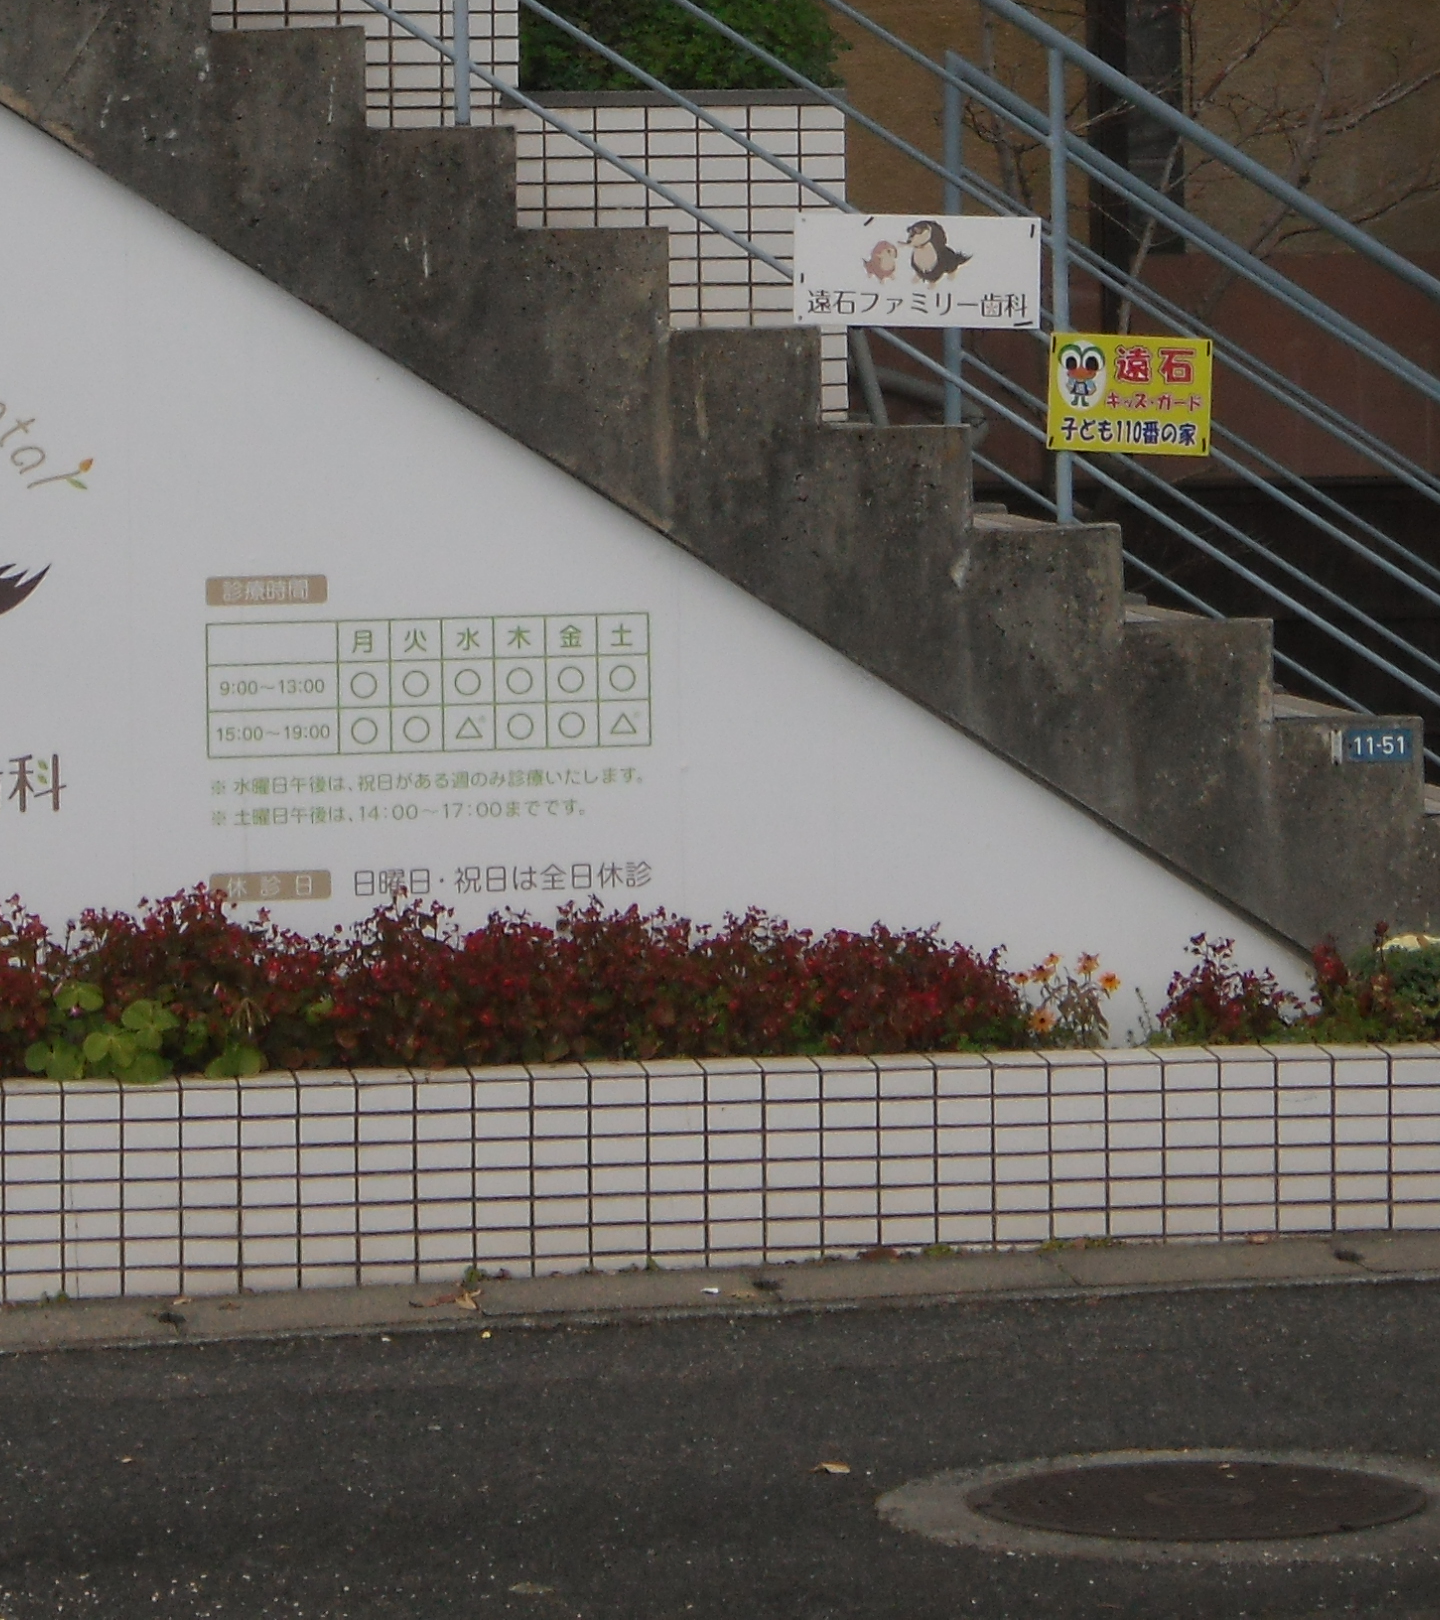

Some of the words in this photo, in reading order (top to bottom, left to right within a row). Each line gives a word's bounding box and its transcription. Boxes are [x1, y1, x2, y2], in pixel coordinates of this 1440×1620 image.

[807, 289, 1029, 319] 遠石ファミリー歯科
[1114, 345, 1196, 385] 遠石
[1061, 417, 1197, 447] 子ども110番の家
[222, 579, 309, 601] 診療時間
[352, 629, 373, 653] 月
[403, 628, 428, 651] 火
[456, 627, 481, 651] 水
[507, 625, 531, 649] 木
[559, 623, 583, 649] 金
[610, 622, 634, 647] 土
[1354, 736, 1404, 755] 11-51
[227, 875, 314, 898] 休診日
[353, 861, 653, 898] 日曜日・祝日は全日休診
